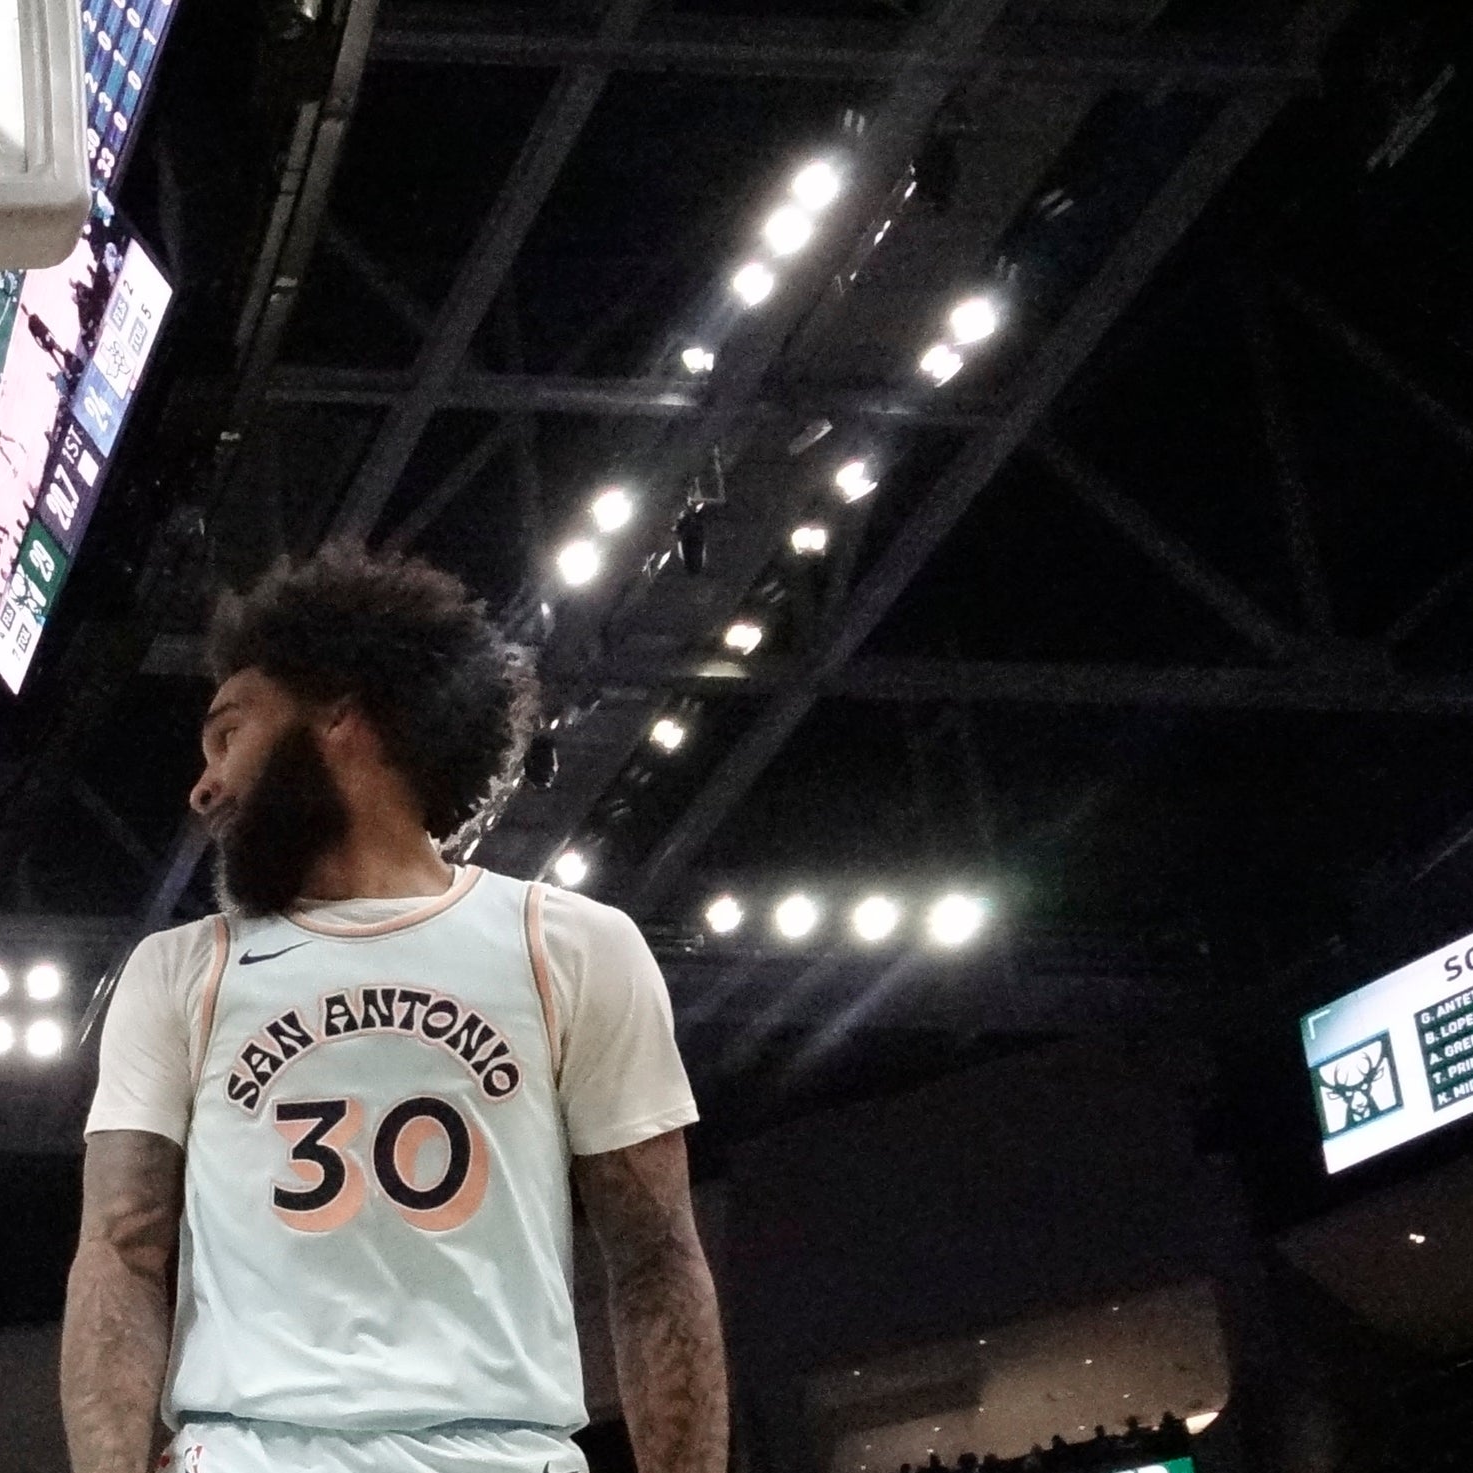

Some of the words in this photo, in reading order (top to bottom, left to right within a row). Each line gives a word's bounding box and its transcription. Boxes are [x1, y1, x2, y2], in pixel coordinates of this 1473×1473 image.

[226, 1010, 316, 1111] SAN
[323, 986, 522, 1101] ANTONIO
[273, 1096, 483, 1228] 30
